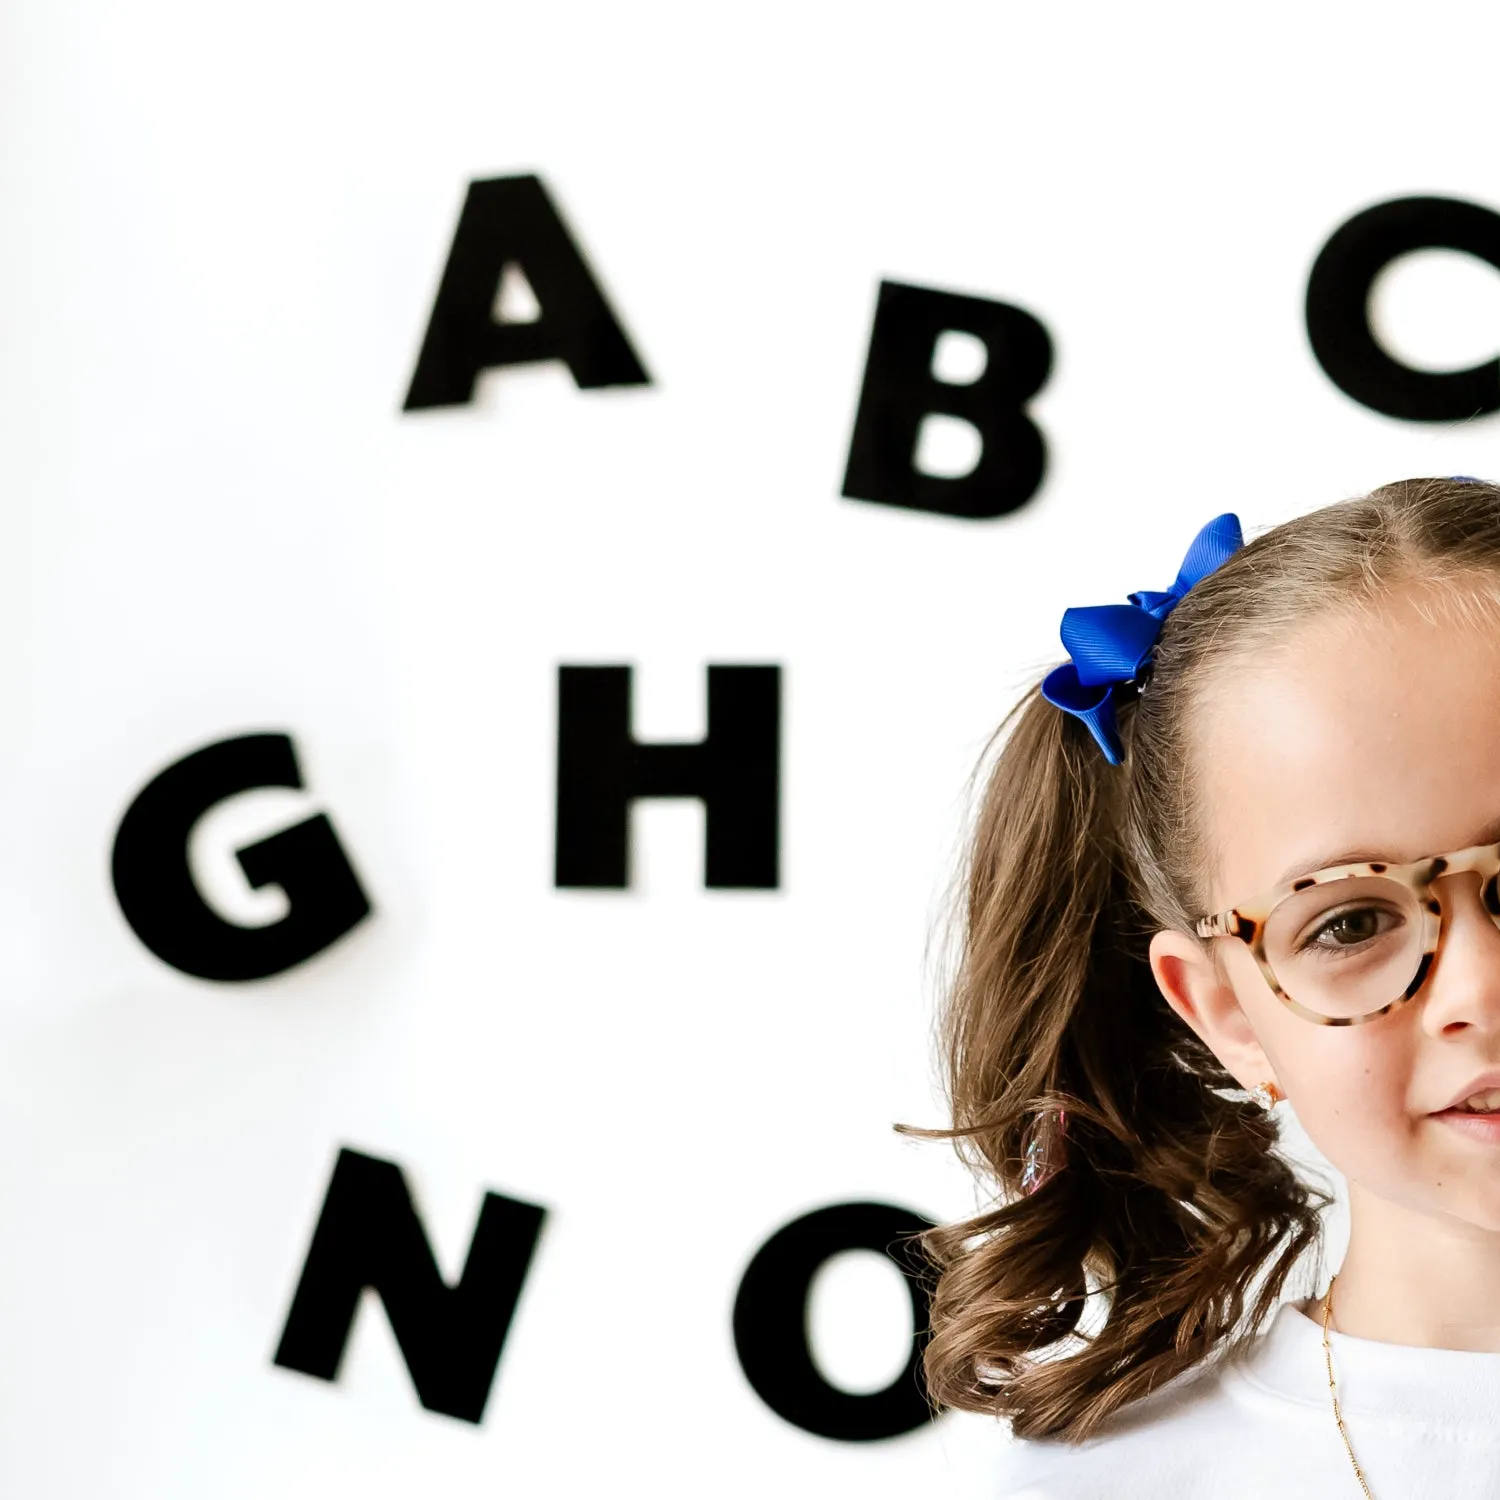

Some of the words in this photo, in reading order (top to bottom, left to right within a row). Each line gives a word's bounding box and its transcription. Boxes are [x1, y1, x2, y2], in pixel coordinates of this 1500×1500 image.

[403, 175, 651, 412] A
[842, 281, 1054, 520] B
[111, 733, 372, 984] G
[555, 665, 784, 889] H
[274, 1148, 547, 1424] N
[733, 1202, 945, 1442] O
